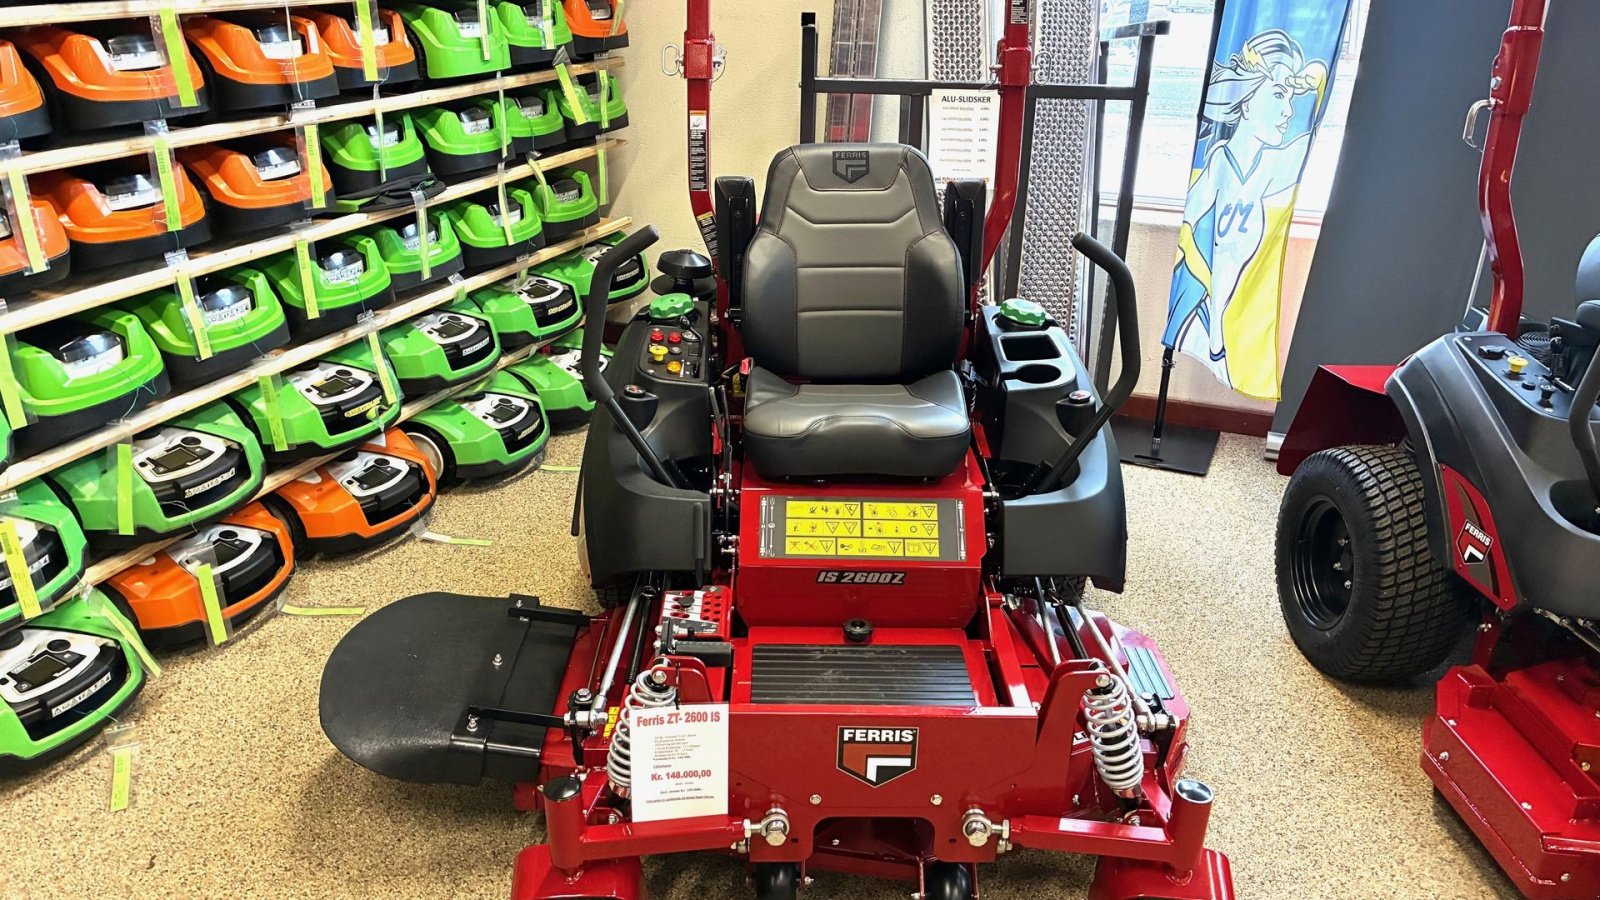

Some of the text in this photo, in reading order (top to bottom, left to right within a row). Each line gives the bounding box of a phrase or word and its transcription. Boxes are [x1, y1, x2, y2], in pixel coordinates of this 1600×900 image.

[941, 95, 992, 104] ALU-SLIDSKER
[835, 151, 867, 159] FERRIS
[1465, 523, 1491, 546] FERRIS
[817, 572, 905, 584] IS 2600Z
[637, 712, 720, 727] Ferris ZT- 2600 IS
[843, 729, 914, 742] FERRIS
[651, 769, 711, 781] Kr. 148.000,00
